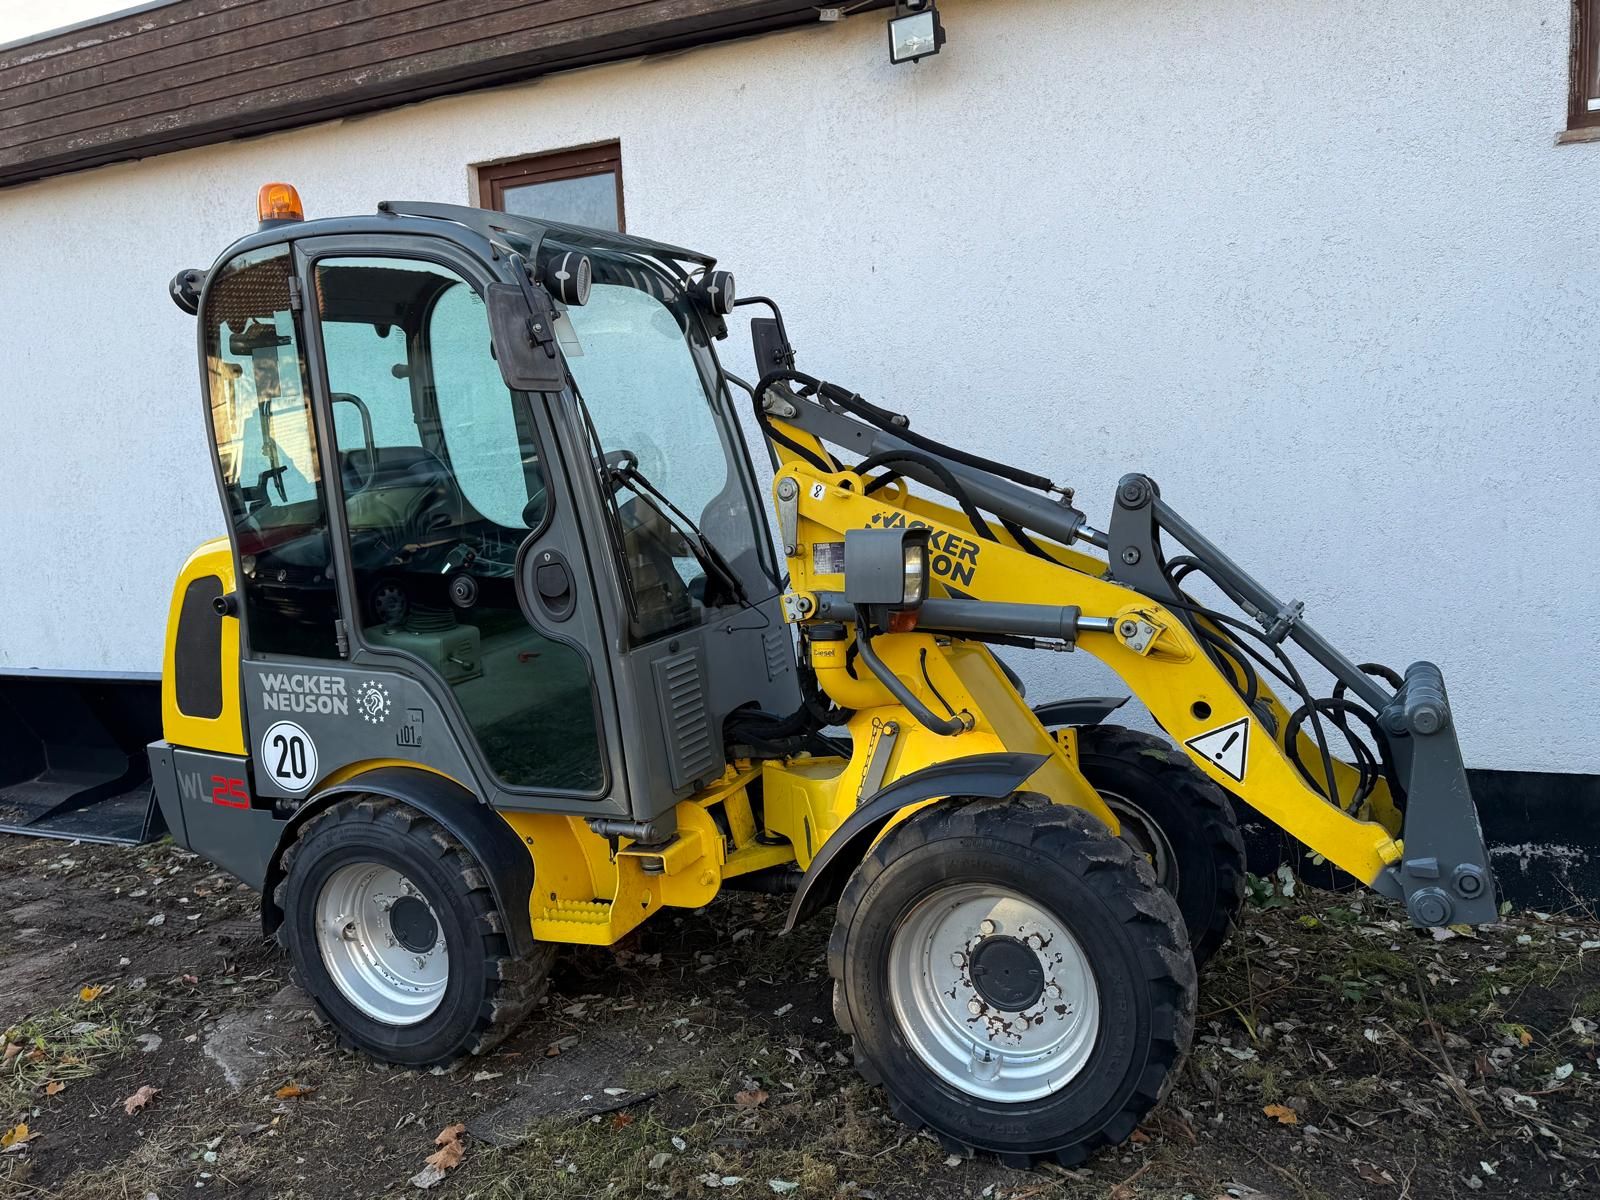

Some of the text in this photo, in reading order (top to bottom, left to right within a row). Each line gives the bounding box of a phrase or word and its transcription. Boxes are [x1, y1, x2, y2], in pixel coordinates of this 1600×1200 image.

[258, 672, 348, 696] WACKER
[262, 691, 349, 716] NEUSON
[400, 725, 415, 744] 101
[273, 734, 307, 780] 20
